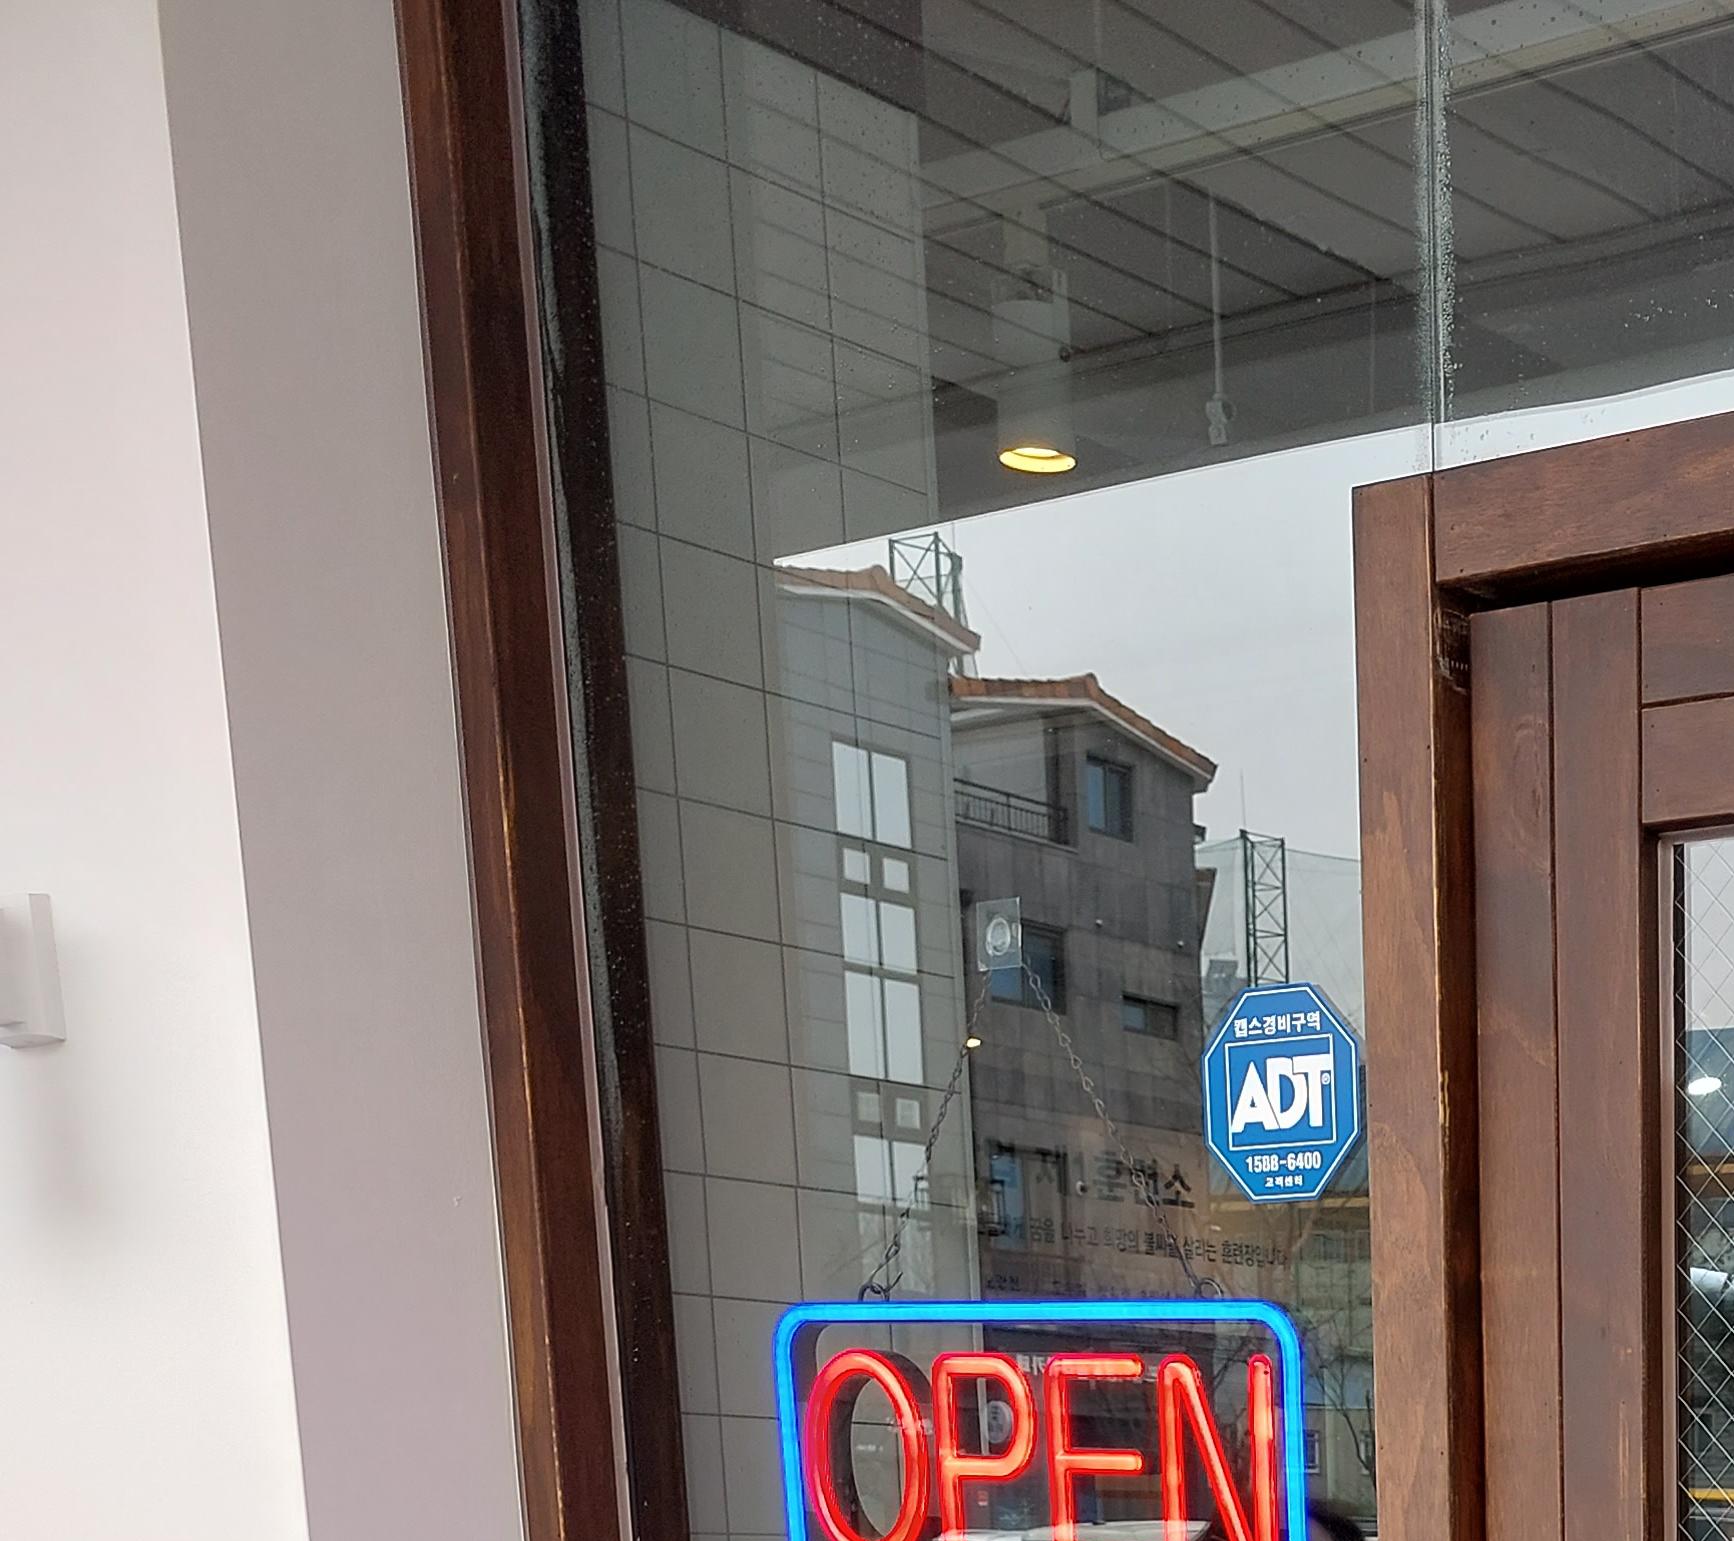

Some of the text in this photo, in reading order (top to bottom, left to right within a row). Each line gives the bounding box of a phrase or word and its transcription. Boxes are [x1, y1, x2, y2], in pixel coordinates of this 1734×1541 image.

[1234, 1010, 1321, 1039] 캡스경비구역
[1231, 1053, 1332, 1133] ADT
[1245, 1151, 1322, 1174] 1588-6400
